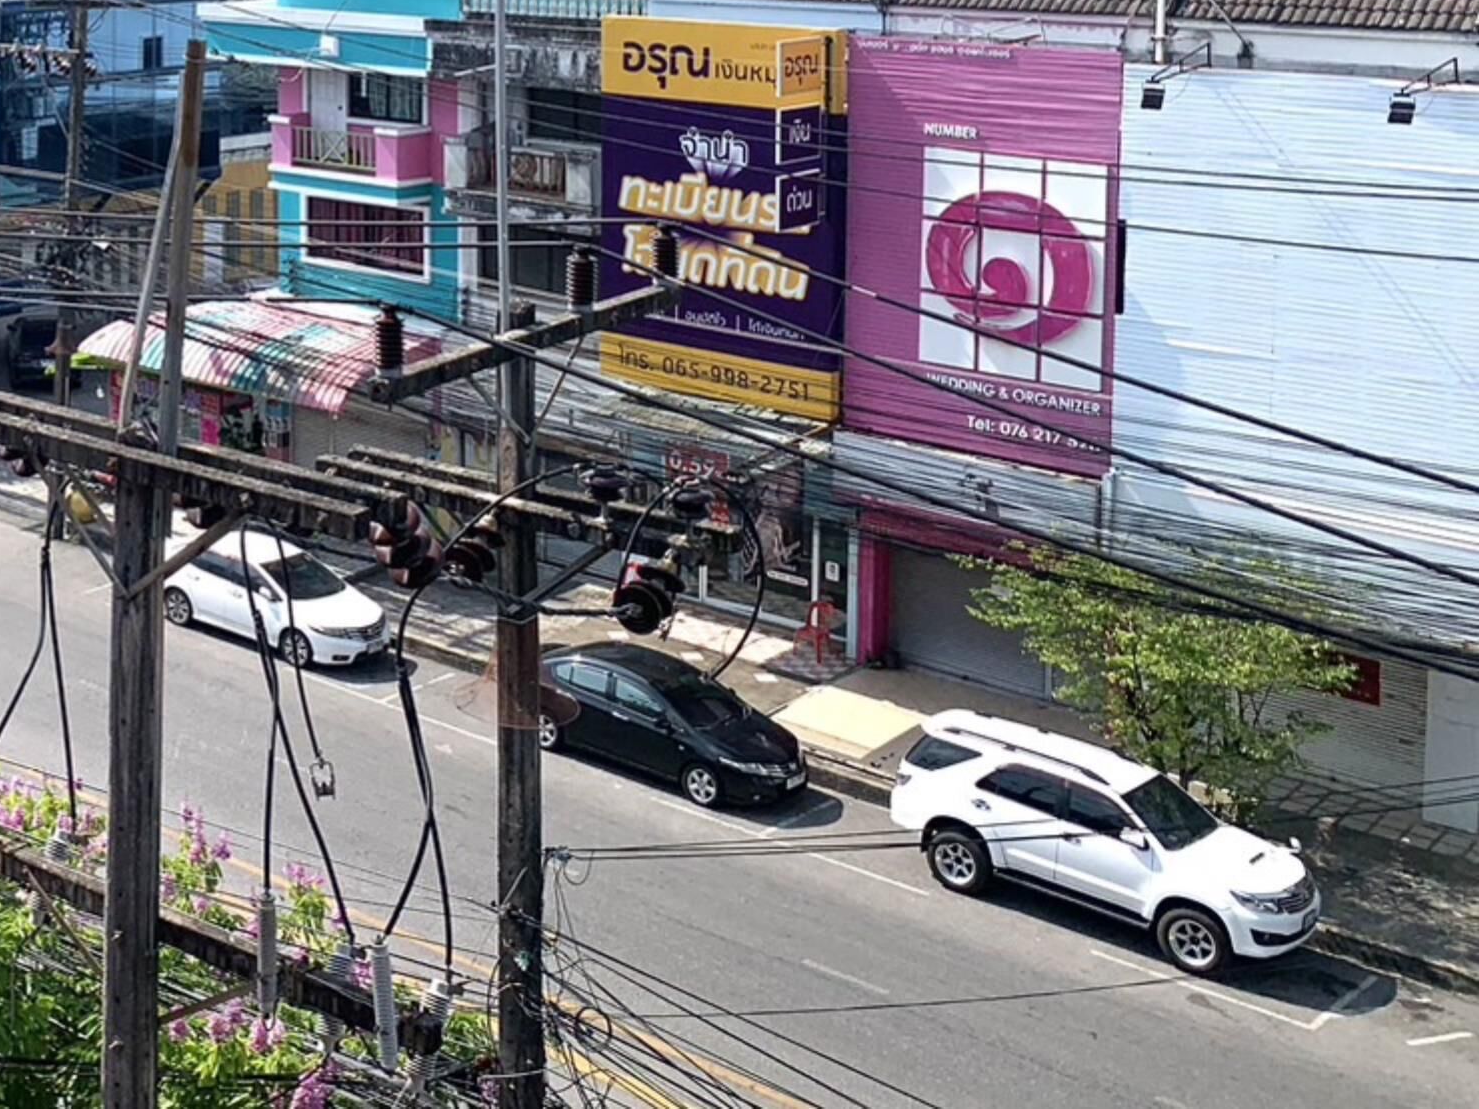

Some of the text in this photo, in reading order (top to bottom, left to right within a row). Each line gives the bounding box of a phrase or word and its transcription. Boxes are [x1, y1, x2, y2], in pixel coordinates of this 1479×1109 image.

[622, 41, 710, 90] อรุณ
[784, 53, 819, 85] อรุณ
[679, 125, 750, 167] จำนำ
[923, 122, 978, 140] NUMBER
[618, 171, 811, 235] ทะเบียนร
[785, 185, 813, 213] ด่วน
[662, 356, 809, 401] 065-998-2751
[998, 385, 1010, 400] &
[1012, 388, 1101, 417] ORGANIZER
[966, 414, 1061, 444] Tel: 076 217
